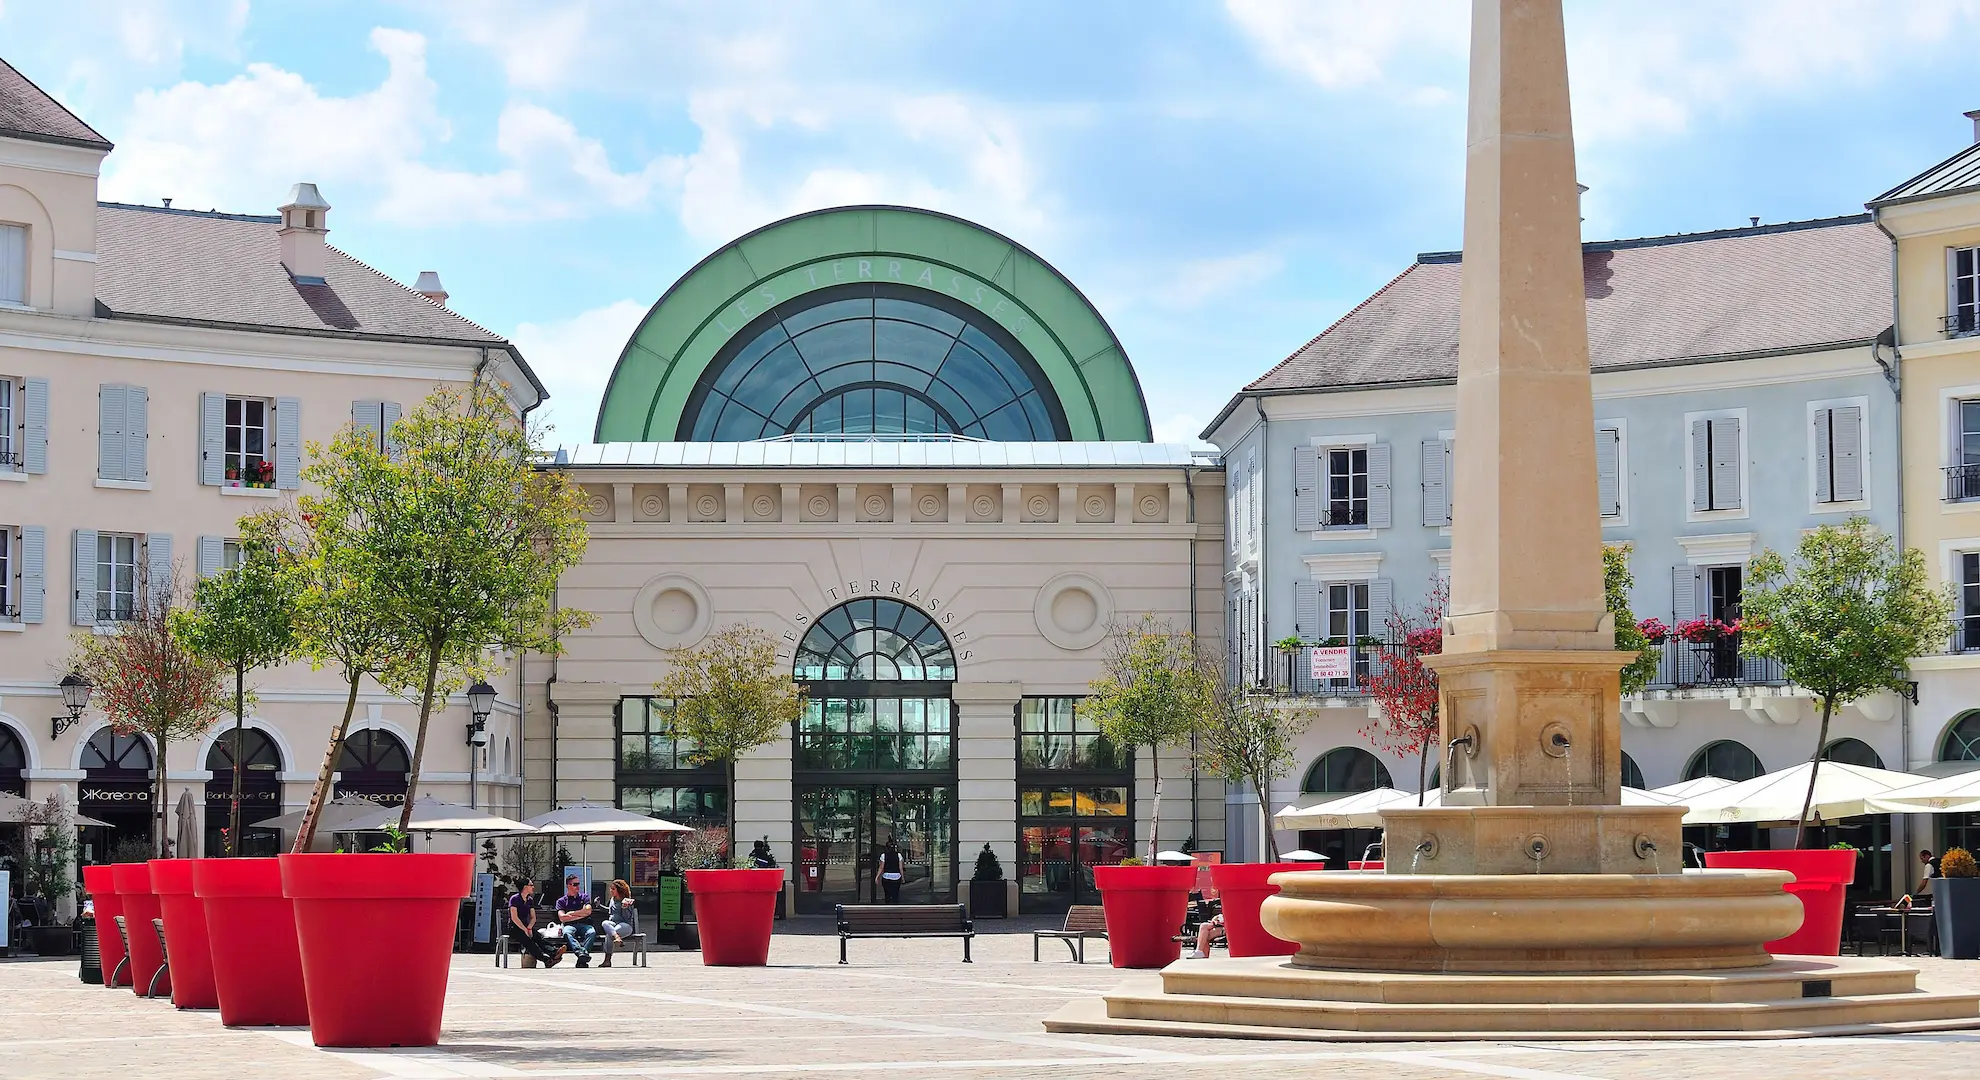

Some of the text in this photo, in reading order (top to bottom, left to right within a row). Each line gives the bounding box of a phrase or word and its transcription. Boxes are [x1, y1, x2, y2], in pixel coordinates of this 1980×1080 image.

[717, 260, 1030, 335] LES TERRASSES
[777, 579, 974, 662] LES TERRASSES
[206, 791, 255, 800] Barbue
